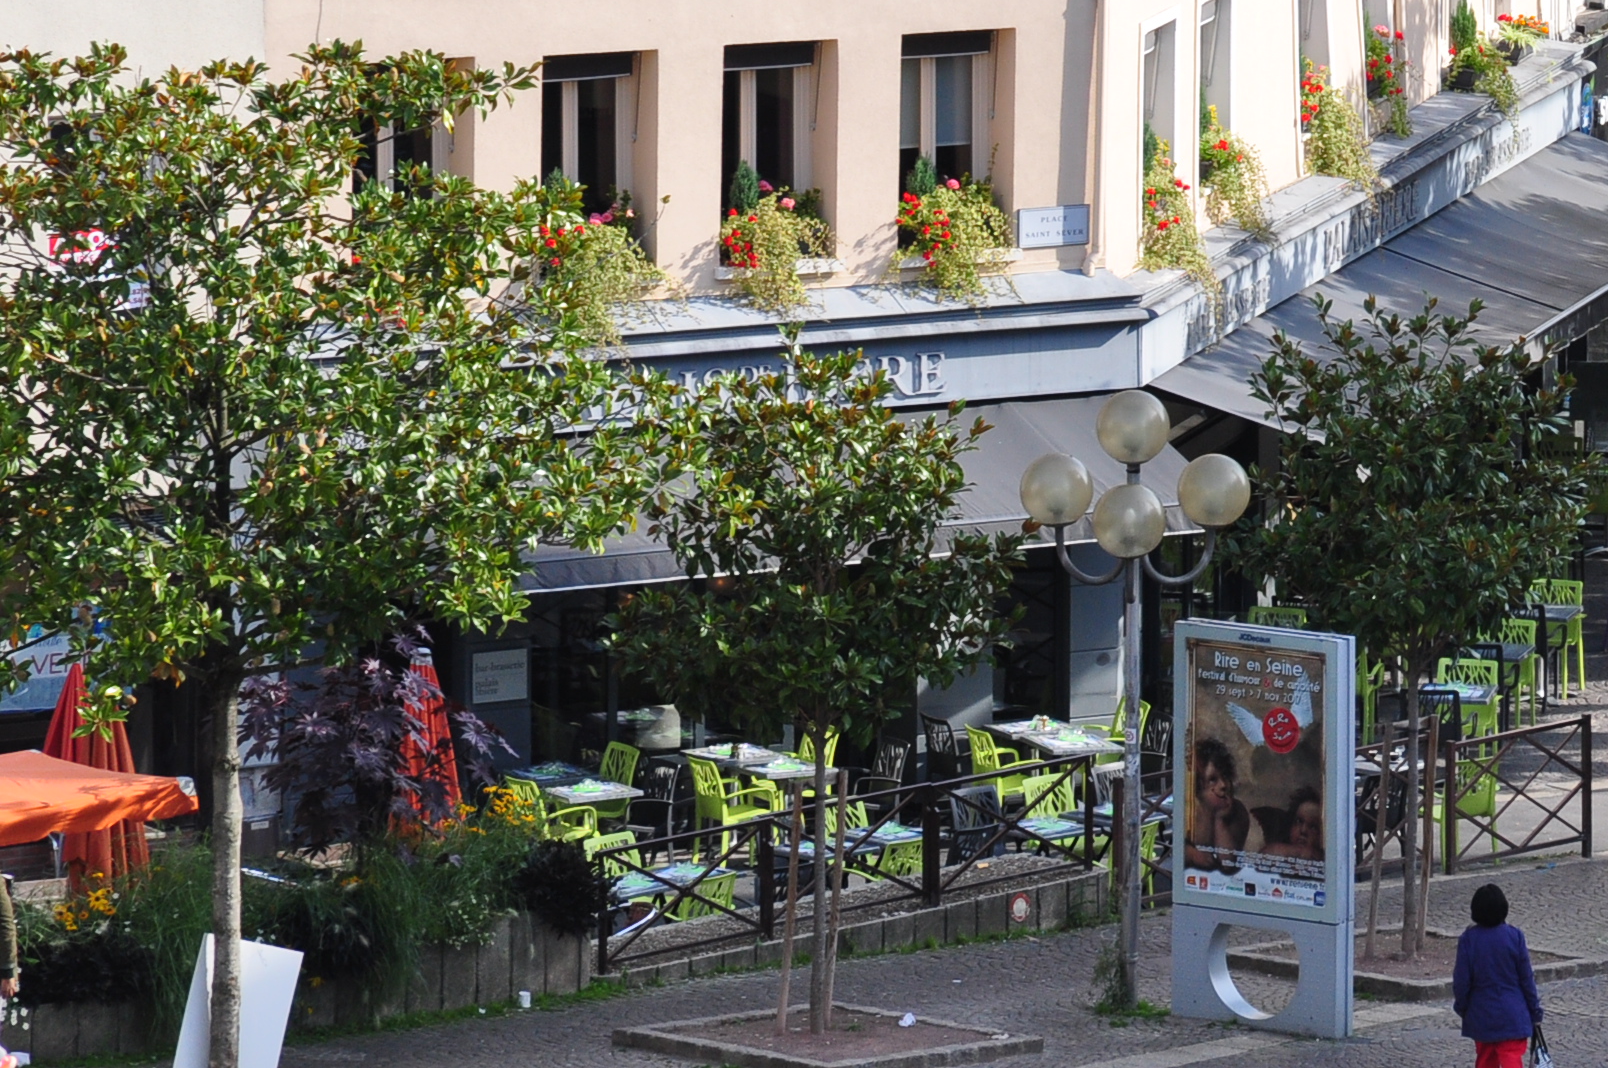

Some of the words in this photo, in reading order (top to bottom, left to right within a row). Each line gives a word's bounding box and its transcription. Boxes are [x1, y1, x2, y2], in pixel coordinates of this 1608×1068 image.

[1040, 215, 1068, 223] PLACE
[1025, 230, 1051, 238] SAINT
[1056, 228, 1084, 237] SEVER
[1214, 651, 1240, 670] Rire
[1246, 661, 1262, 673] en
[1265, 657, 1304, 677] Seine
[1273, 679, 1285, 689] de
[1215, 684, 1226, 696] 29
[1264, 695, 1280, 703] nov
